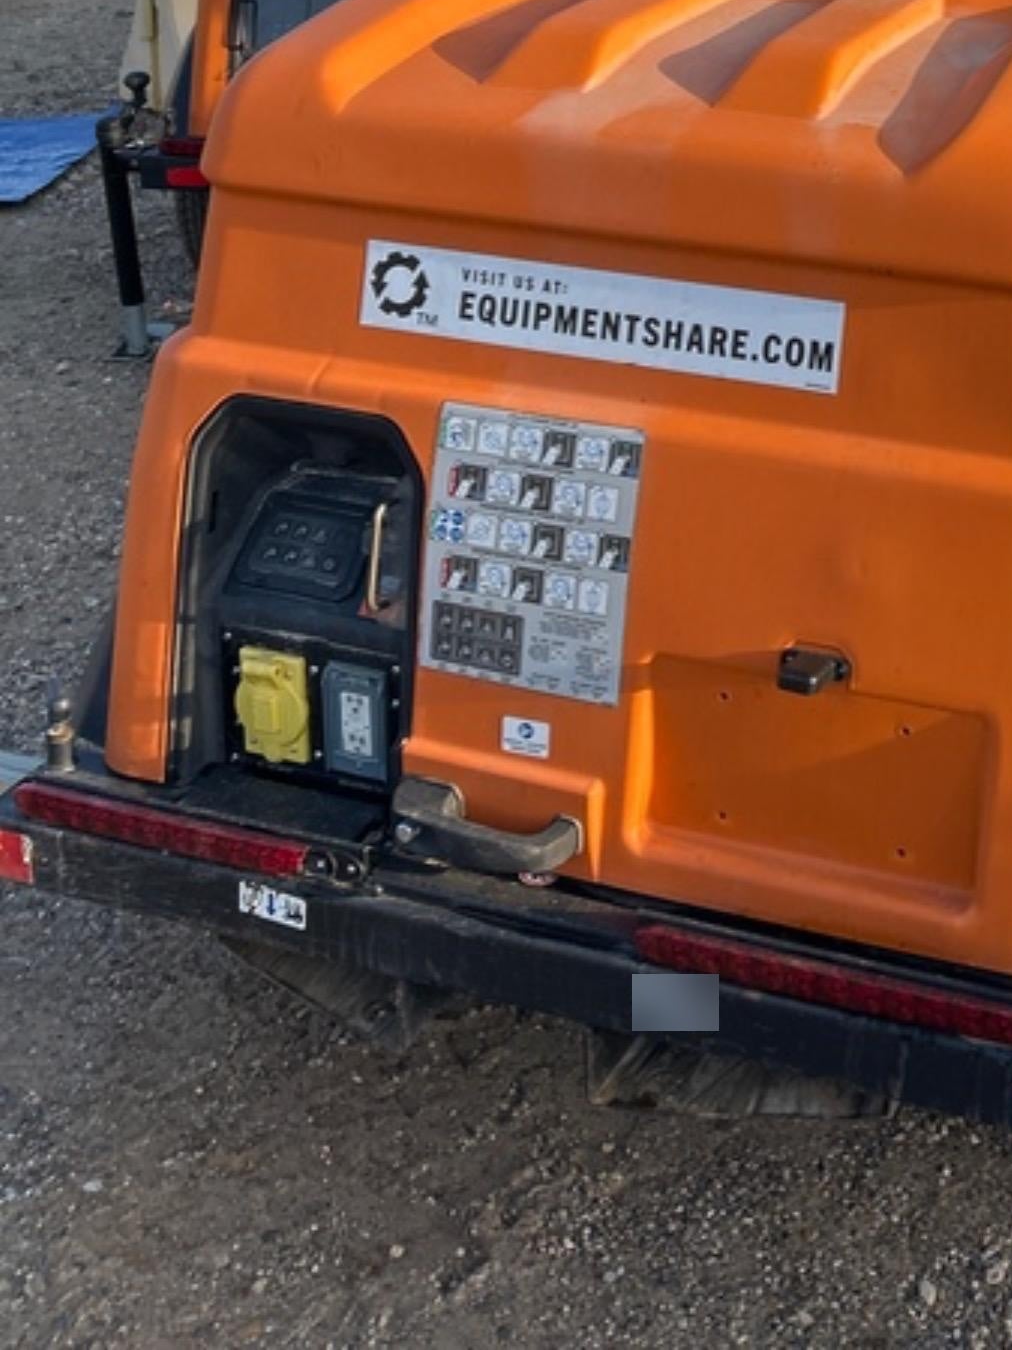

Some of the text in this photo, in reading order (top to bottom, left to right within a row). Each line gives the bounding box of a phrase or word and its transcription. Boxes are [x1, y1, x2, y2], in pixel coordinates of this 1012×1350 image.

[461, 267, 569, 295] VISIT US AT:
[458, 290, 836, 373] EQUIPMENTSHARE.COM
